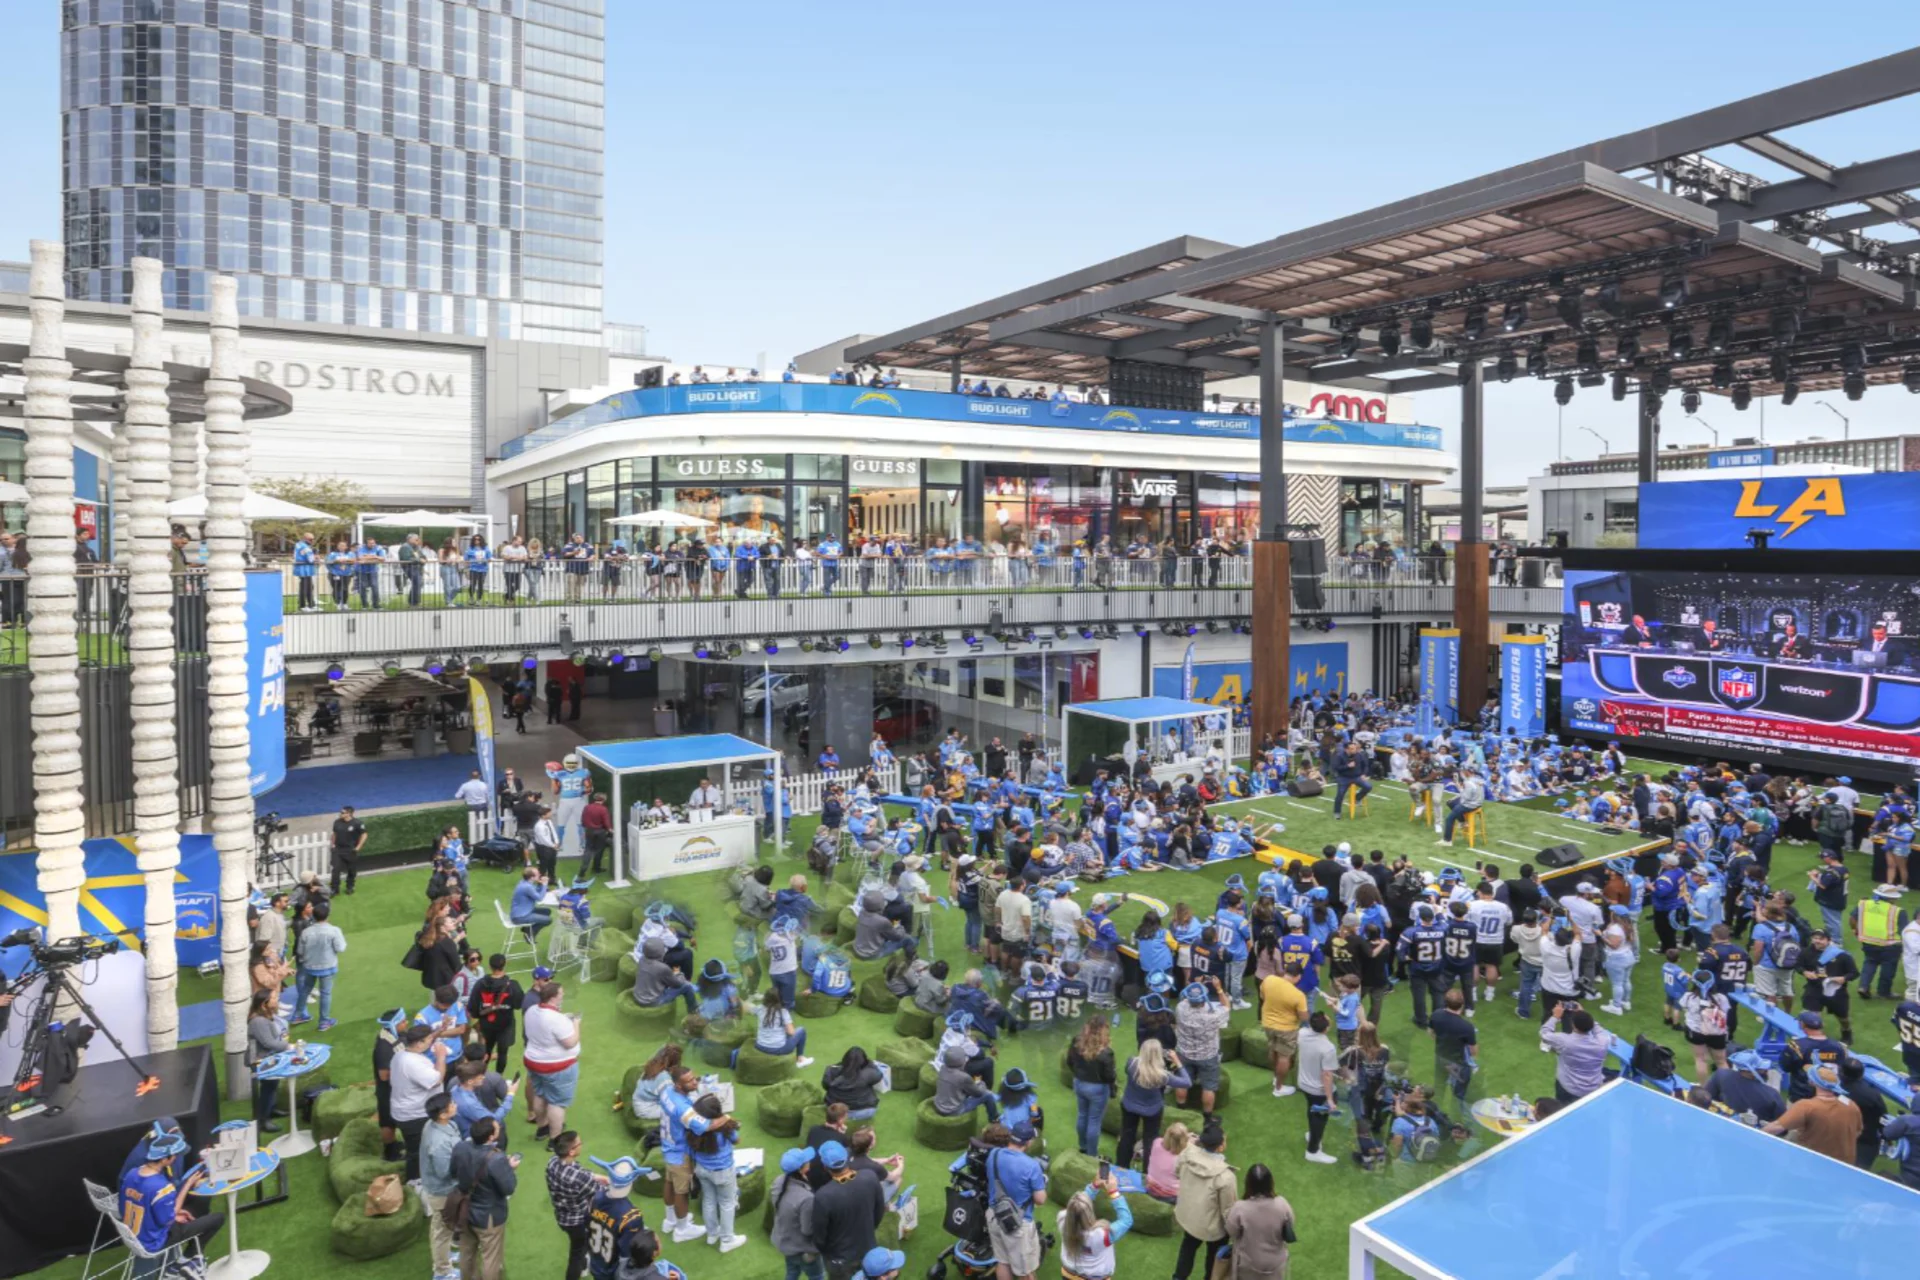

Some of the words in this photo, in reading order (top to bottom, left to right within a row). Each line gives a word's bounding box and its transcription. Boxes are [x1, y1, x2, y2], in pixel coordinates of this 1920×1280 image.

[254, 359, 455, 397] RDSTROM
[689, 392, 713, 402] BUD
[715, 390, 757, 402] LIGHT
[970, 403, 995, 414] BUD
[996, 405, 1028, 416] LIGHT
[1307, 393, 1387, 424] amc
[1220, 420, 1248, 430] LIGHT
[678, 459, 765, 476] GUESS
[853, 460, 917, 474] GUESS
[1131, 478, 1178, 497] VANS
[1734, 478, 1846, 540] LA
[1511, 647, 1524, 720] CHARGERS
[1721, 681, 1752, 698] NFL
[1780, 684, 1826, 698] verizon
[1688, 711, 1711, 722] Paris
[1713, 714, 1756, 727] Johnson
[1809, 735, 1835, 745] block
[1866, 741, 1876, 749] in
[1878, 744, 1911, 754] career
[562, 778, 583, 791] 52
[1479, 916, 1501, 935] 10
[1417, 941, 1442, 962] 21
[1445, 937, 1473, 959] 85
[828, 970, 848, 988] 10
[1721, 961, 1748, 981] 52
[1090, 976, 1111, 993] 10
[1029, 1001, 1054, 1021] 21
[1056, 996, 1085, 1018] 85
[590, 1220, 614, 1263] 33
